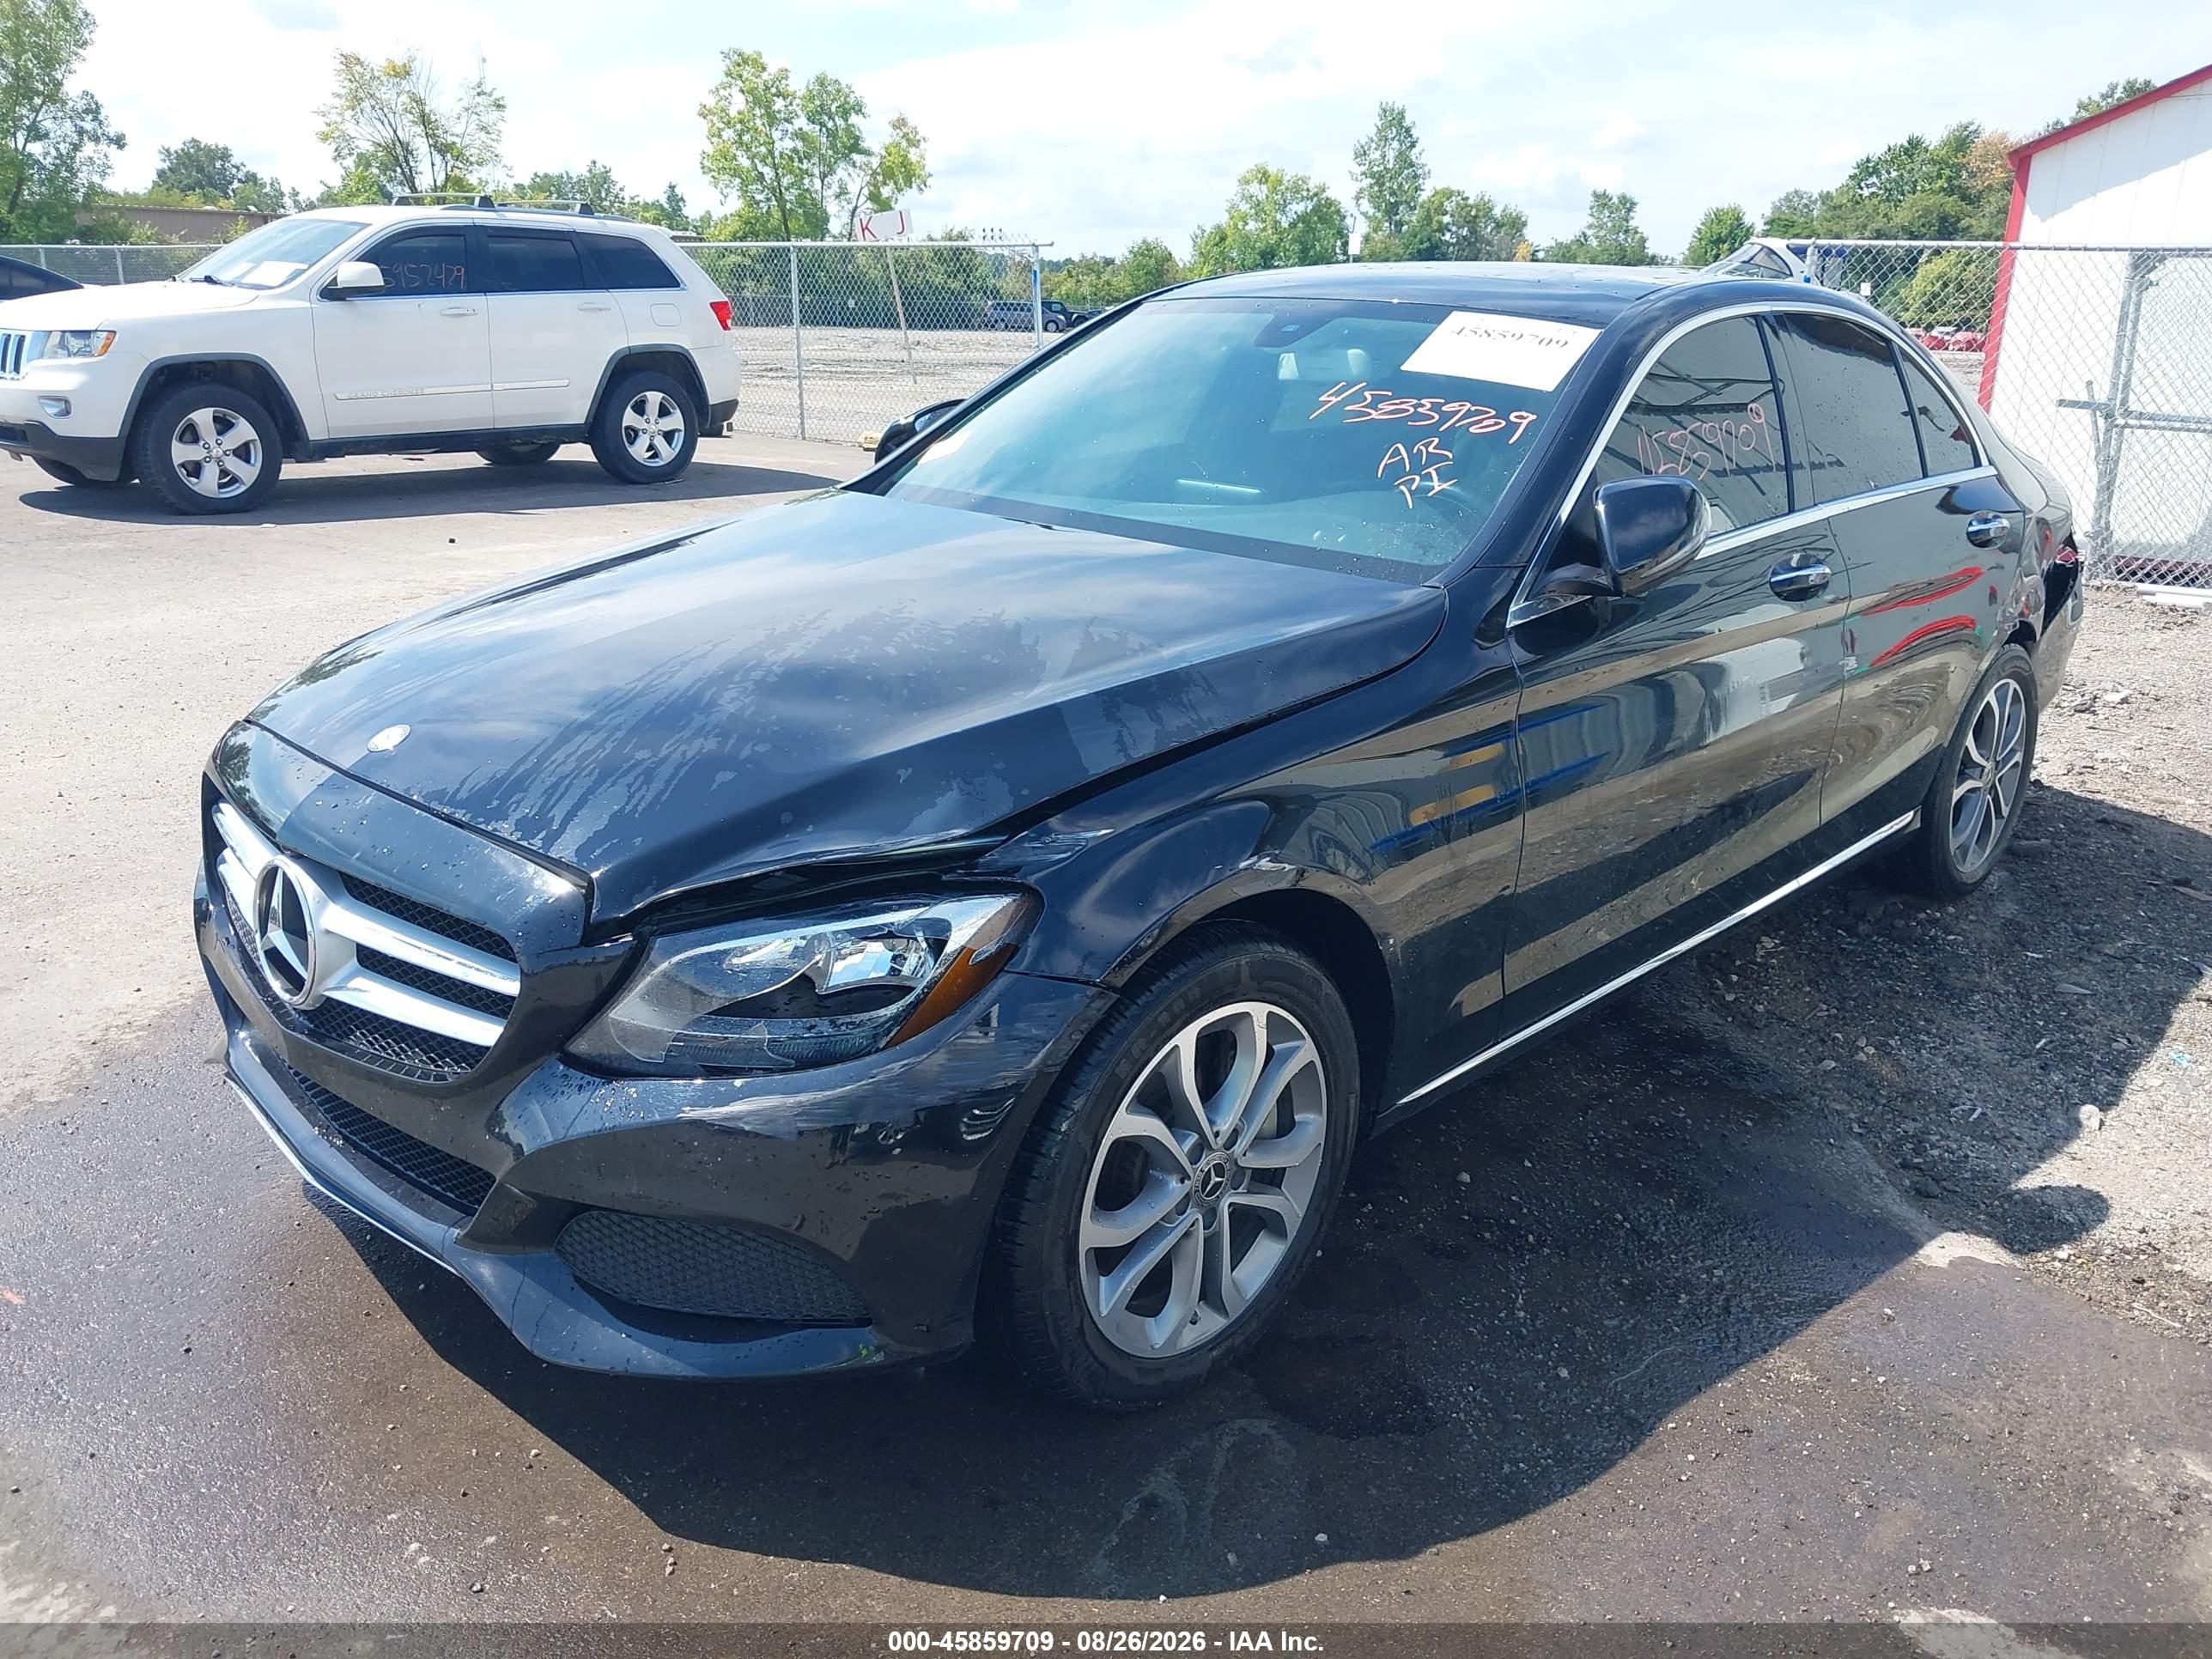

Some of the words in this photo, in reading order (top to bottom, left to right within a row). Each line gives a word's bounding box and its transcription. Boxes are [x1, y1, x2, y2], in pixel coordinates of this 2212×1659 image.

[860, 216, 878, 241] K
[1450, 325, 1570, 348] 45859709
[1309, 381, 1538, 444] 45859709
